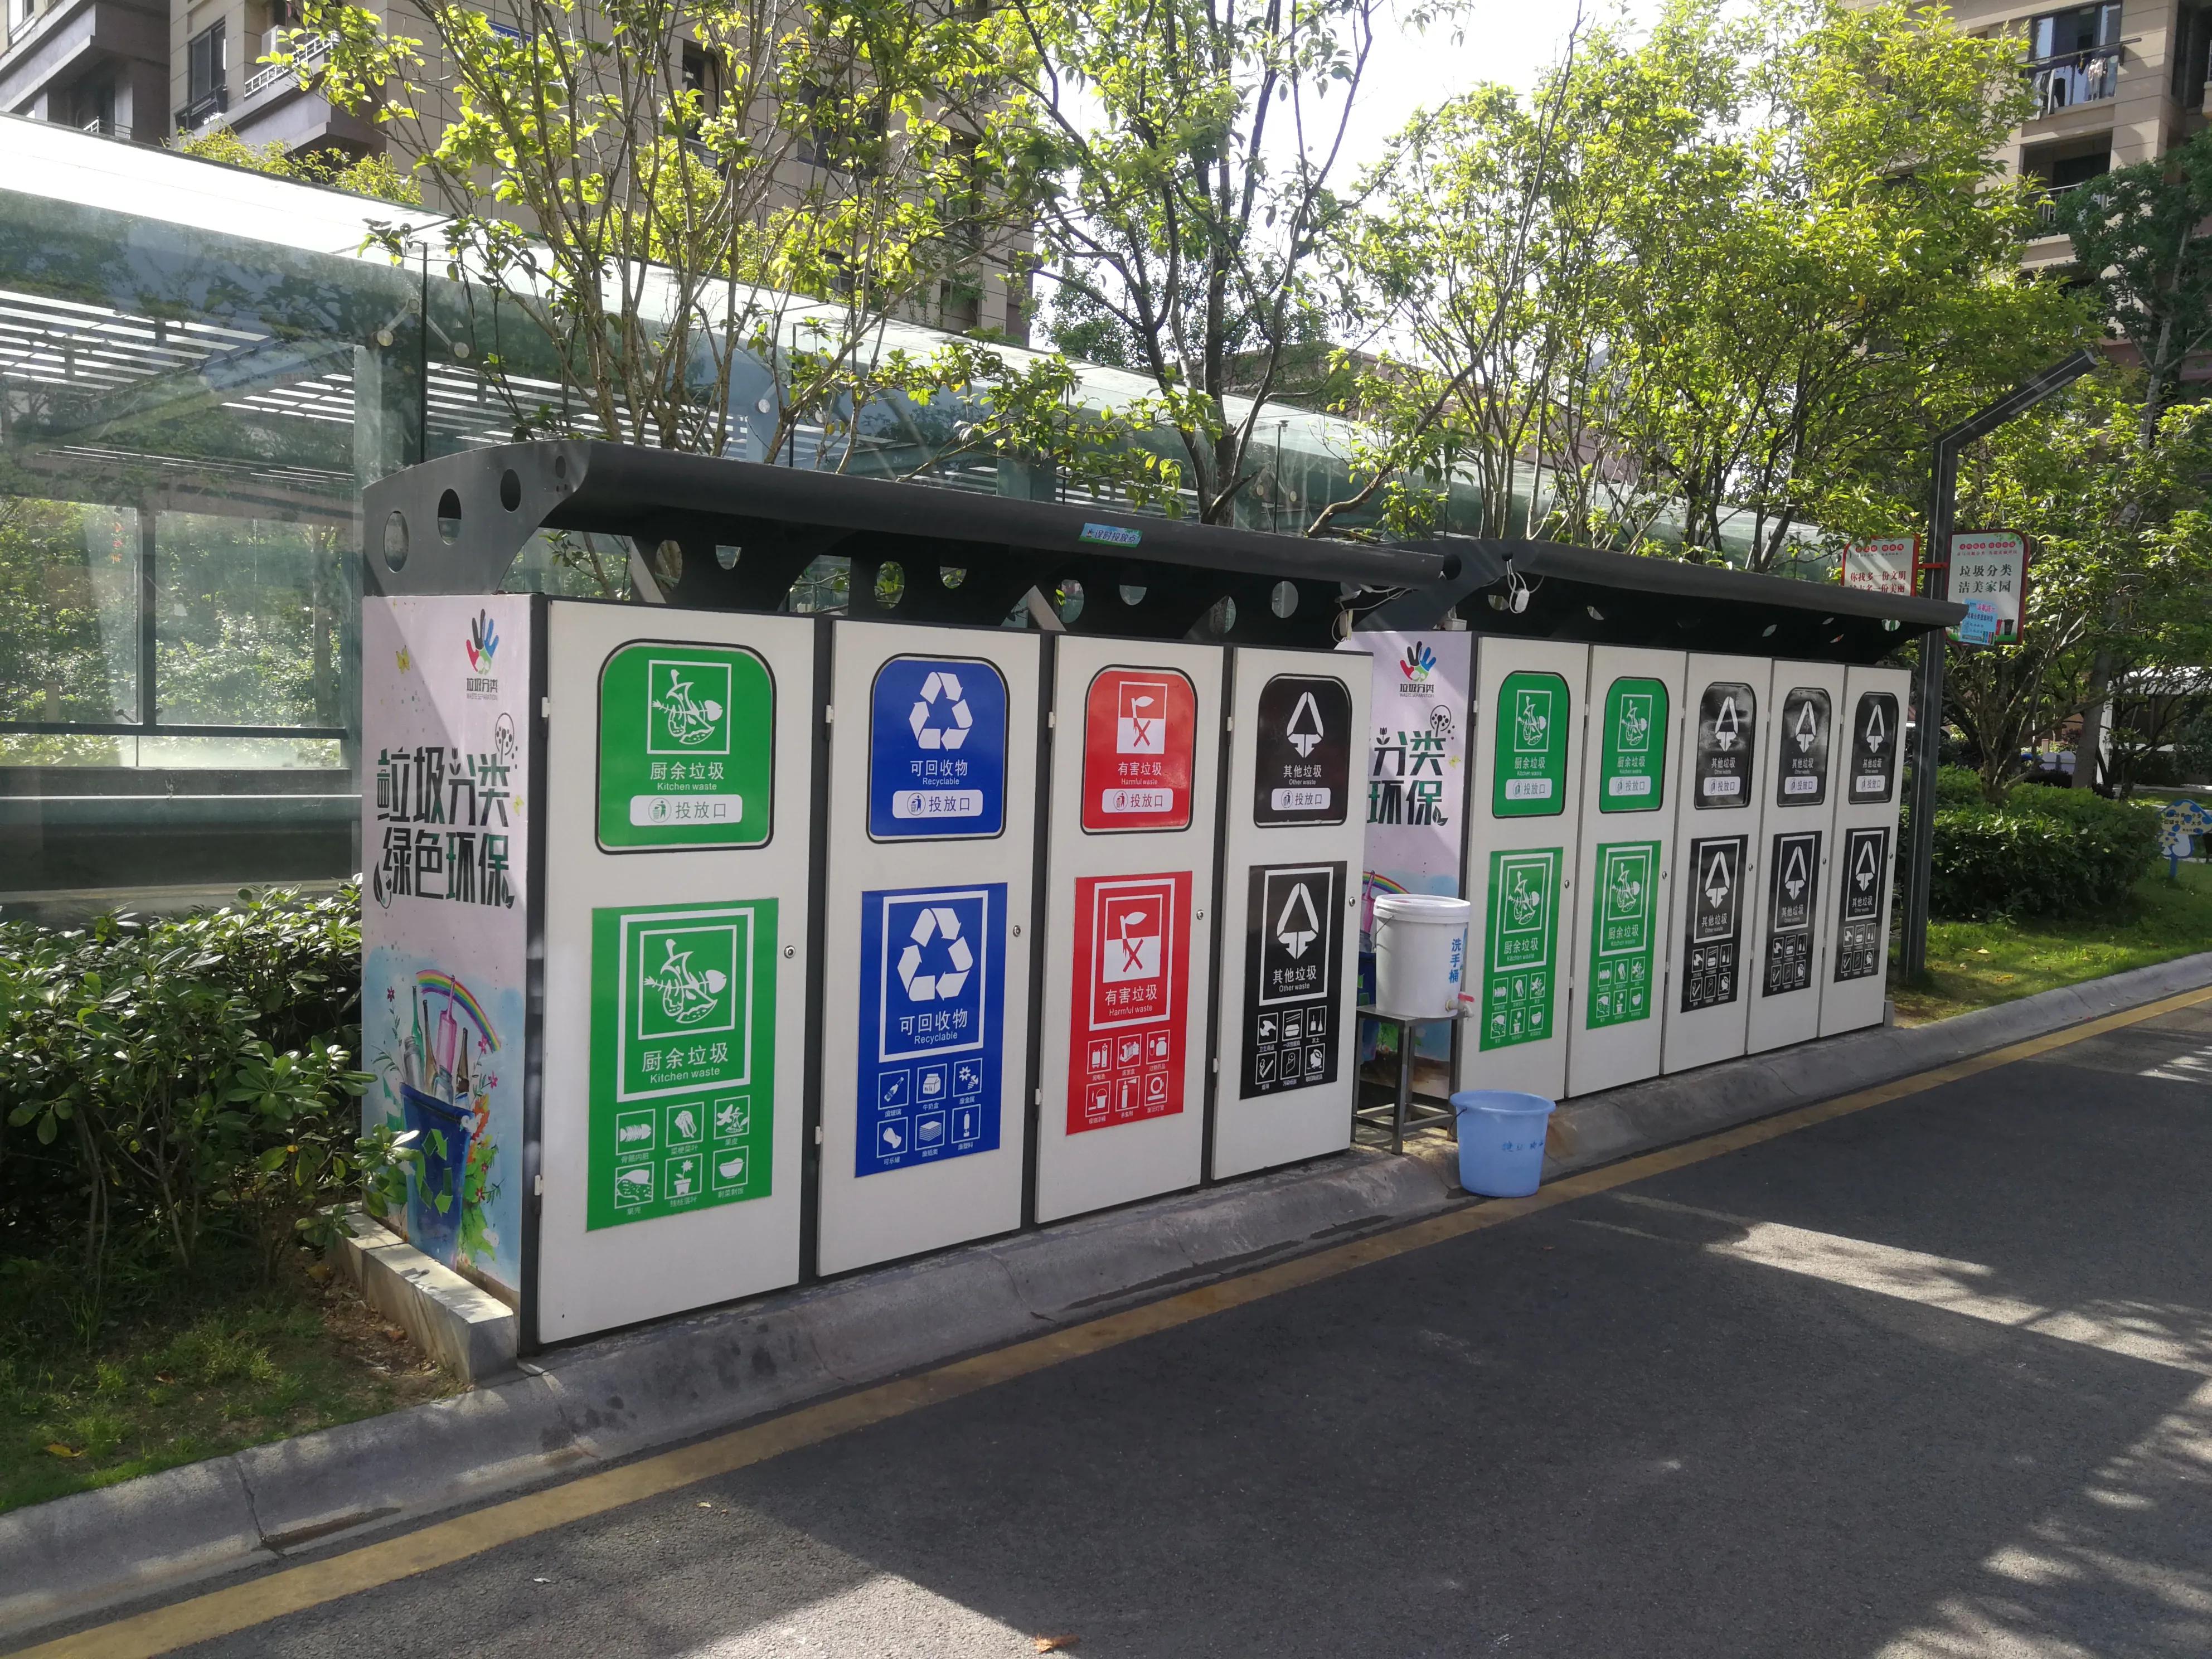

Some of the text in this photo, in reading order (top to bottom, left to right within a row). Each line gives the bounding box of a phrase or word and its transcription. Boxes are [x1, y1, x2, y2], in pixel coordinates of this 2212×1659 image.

[1851, 571, 1906, 582] 你我多一份文明
[1959, 563, 2012, 577] 垃圾分类
[1850, 583, 1905, 593] 多一份美丽
[1958, 580, 2011, 594] 洁美家园
[467, 678, 498, 692] 垃圾分类
[1400, 683, 1434, 692] 垃圾分类
[1373, 727, 1446, 776] 分类
[910, 759, 968, 777] 可回收物
[1118, 761, 1162, 775] 有害垃圾
[1515, 756, 1545, 769] 厨余垃圾
[1617, 756, 1646, 768] 厨余垃圾
[1711, 757, 1735, 768] 其他垃圾
[1792, 758, 1813, 768] 其他垃圾
[1862, 758, 1882, 768] 其他垃圾
[650, 761, 724, 780] 厨余垃圾
[1283, 764, 1322, 778] 其他垃圾
[377, 746, 511, 827] 垃圾分类
[923, 778, 959, 787] Recyclable
[1524, 783, 1545, 795] 投放口
[1625, 780, 1645, 791] 投放口
[1718, 780, 1735, 792] 投放口
[929, 796, 970, 812] 投放口
[1131, 793, 1163, 808] 投放口
[1295, 792, 1322, 806] 投放口
[1367, 780, 1448, 826] 环保
[675, 802, 726, 819] 投放口
[376, 826, 515, 909] 绿色环保
[1852, 895, 1873, 908] 其他垃圾
[1781, 904, 1804, 918] 其他垃圾
[1701, 913, 1728, 928] 其他垃圾
[1608, 924, 1639, 940] 厨余垃圾
[1504, 938, 1538, 954] 厨余垃圾
[1449, 938, 1461, 983] 洗手桶
[1273, 965, 1317, 984] 其他垃圾
[1105, 984, 1157, 1006] 有害垃圾
[1109, 1005, 1153, 1016] Harmful waste
[899, 1008, 968, 1036] 可回收物
[914, 1031, 958, 1045] Recyclable
[642, 1042, 729, 1073] 厨余垃圾
[650, 1066, 720, 1084] Kitchen waste
[923, 1102, 939, 1110] 牛奶盒
[884, 1156, 900, 1165] 可乐罐
